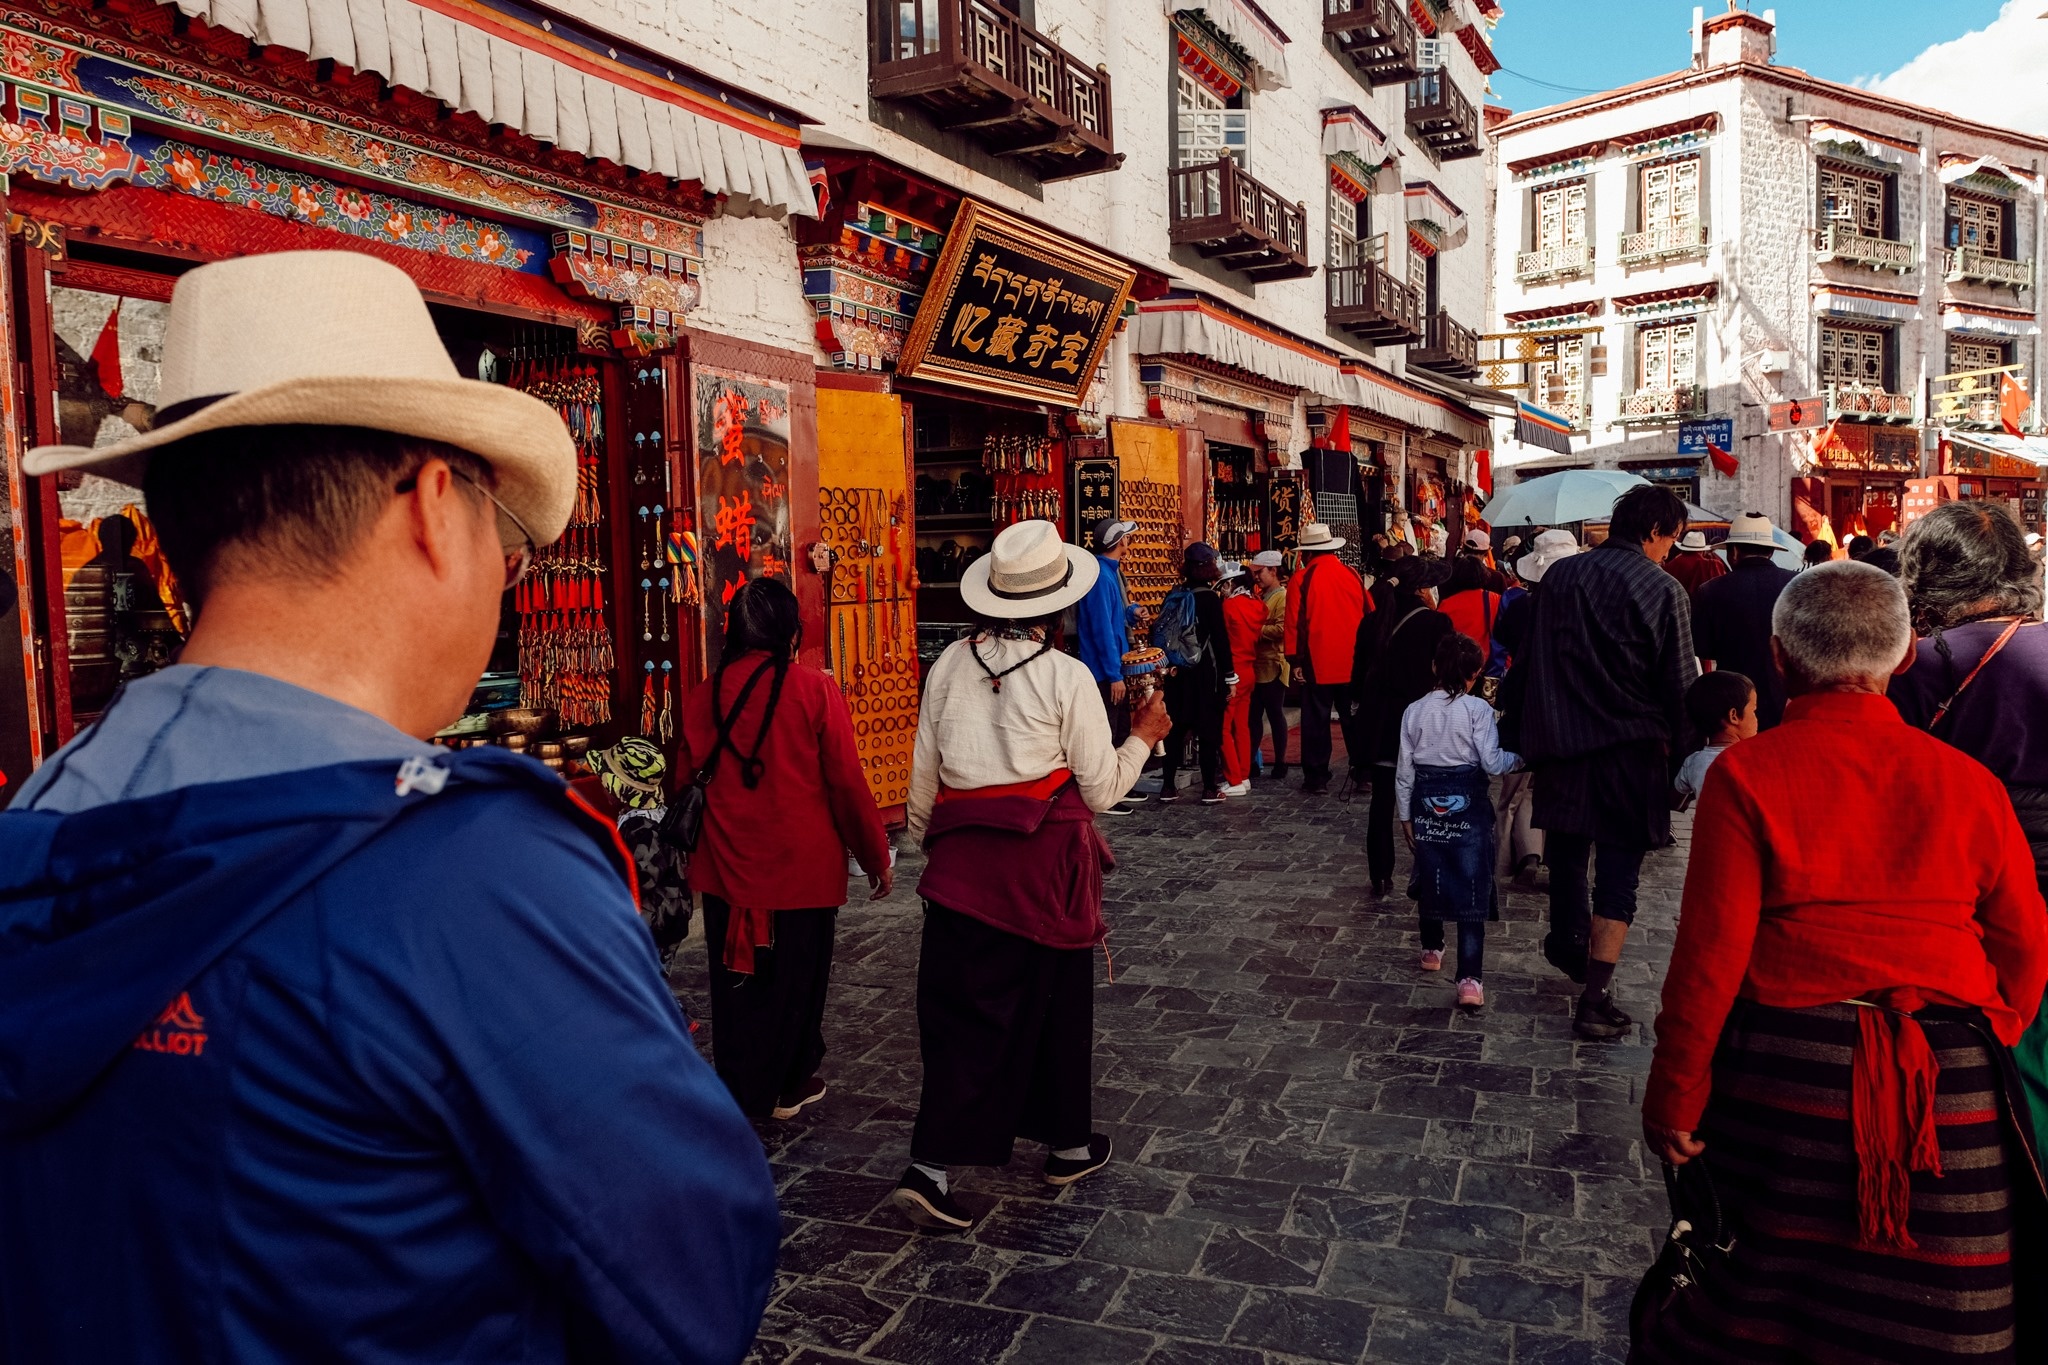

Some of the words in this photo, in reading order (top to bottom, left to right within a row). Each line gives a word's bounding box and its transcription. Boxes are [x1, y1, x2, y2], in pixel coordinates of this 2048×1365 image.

[951, 302, 1089, 375] 忆藏奇宝
[1682, 433, 1729, 446] 安全出口
[1083, 484, 1110, 498] 专营
[1083, 531, 1094, 549] 天
